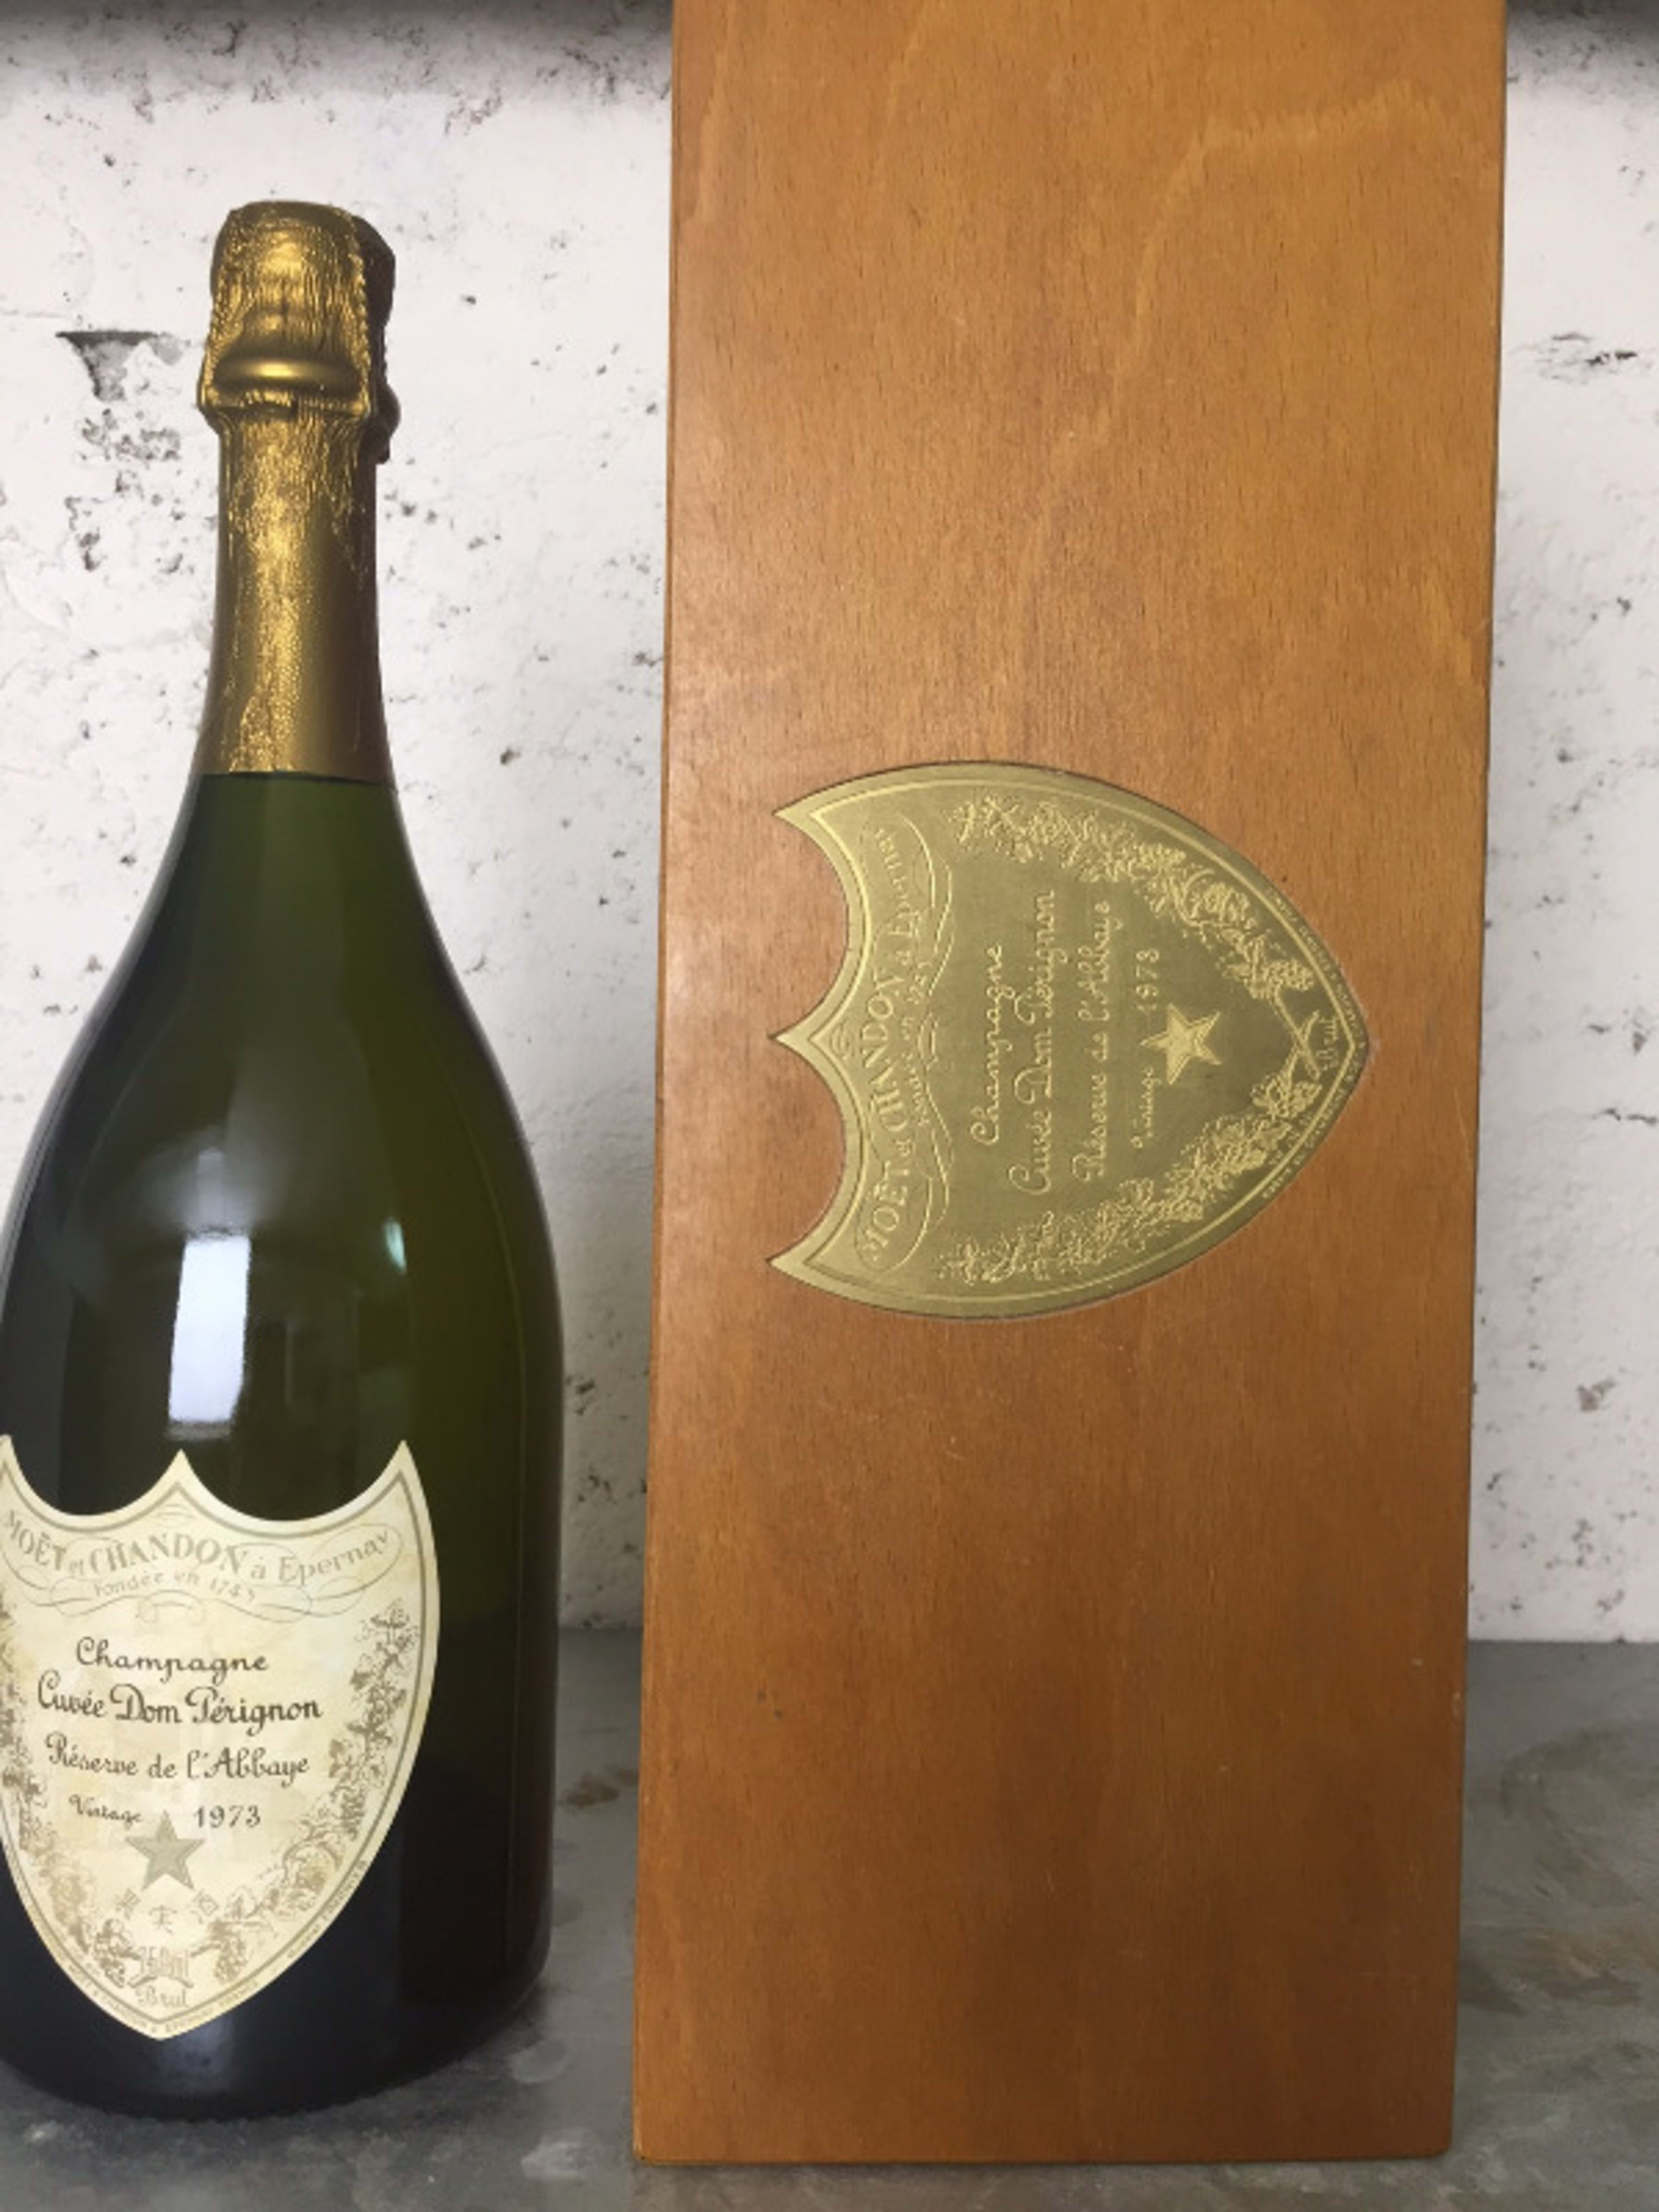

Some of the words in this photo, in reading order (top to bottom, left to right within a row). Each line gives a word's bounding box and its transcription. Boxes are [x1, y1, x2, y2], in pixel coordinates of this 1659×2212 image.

[1014, 889, 1068, 1024] Pérignon
[1135, 948, 1159, 1011] 1973
[861, 967, 909, 1132] CHANDON
[969, 944, 1015, 1145] Champagne
[1014, 1026, 1052, 1104] Dom
[1007, 1110, 1052, 1194] Cuvée
[1071, 1072, 1108, 1181] Réserve
[89, 1532, 248, 1575] CHANDON
[76, 1636, 269, 1686] Champagne
[38, 1668, 108, 1718] Cuvée
[110, 1683, 183, 1723] Dom
[184, 1686, 323, 1737] Pérignon
[45, 1730, 139, 1776] Réserve
[148, 1752, 178, 1778] de
[68, 1794, 142, 1831] Vintage
[194, 1805, 261, 1828] 1973
